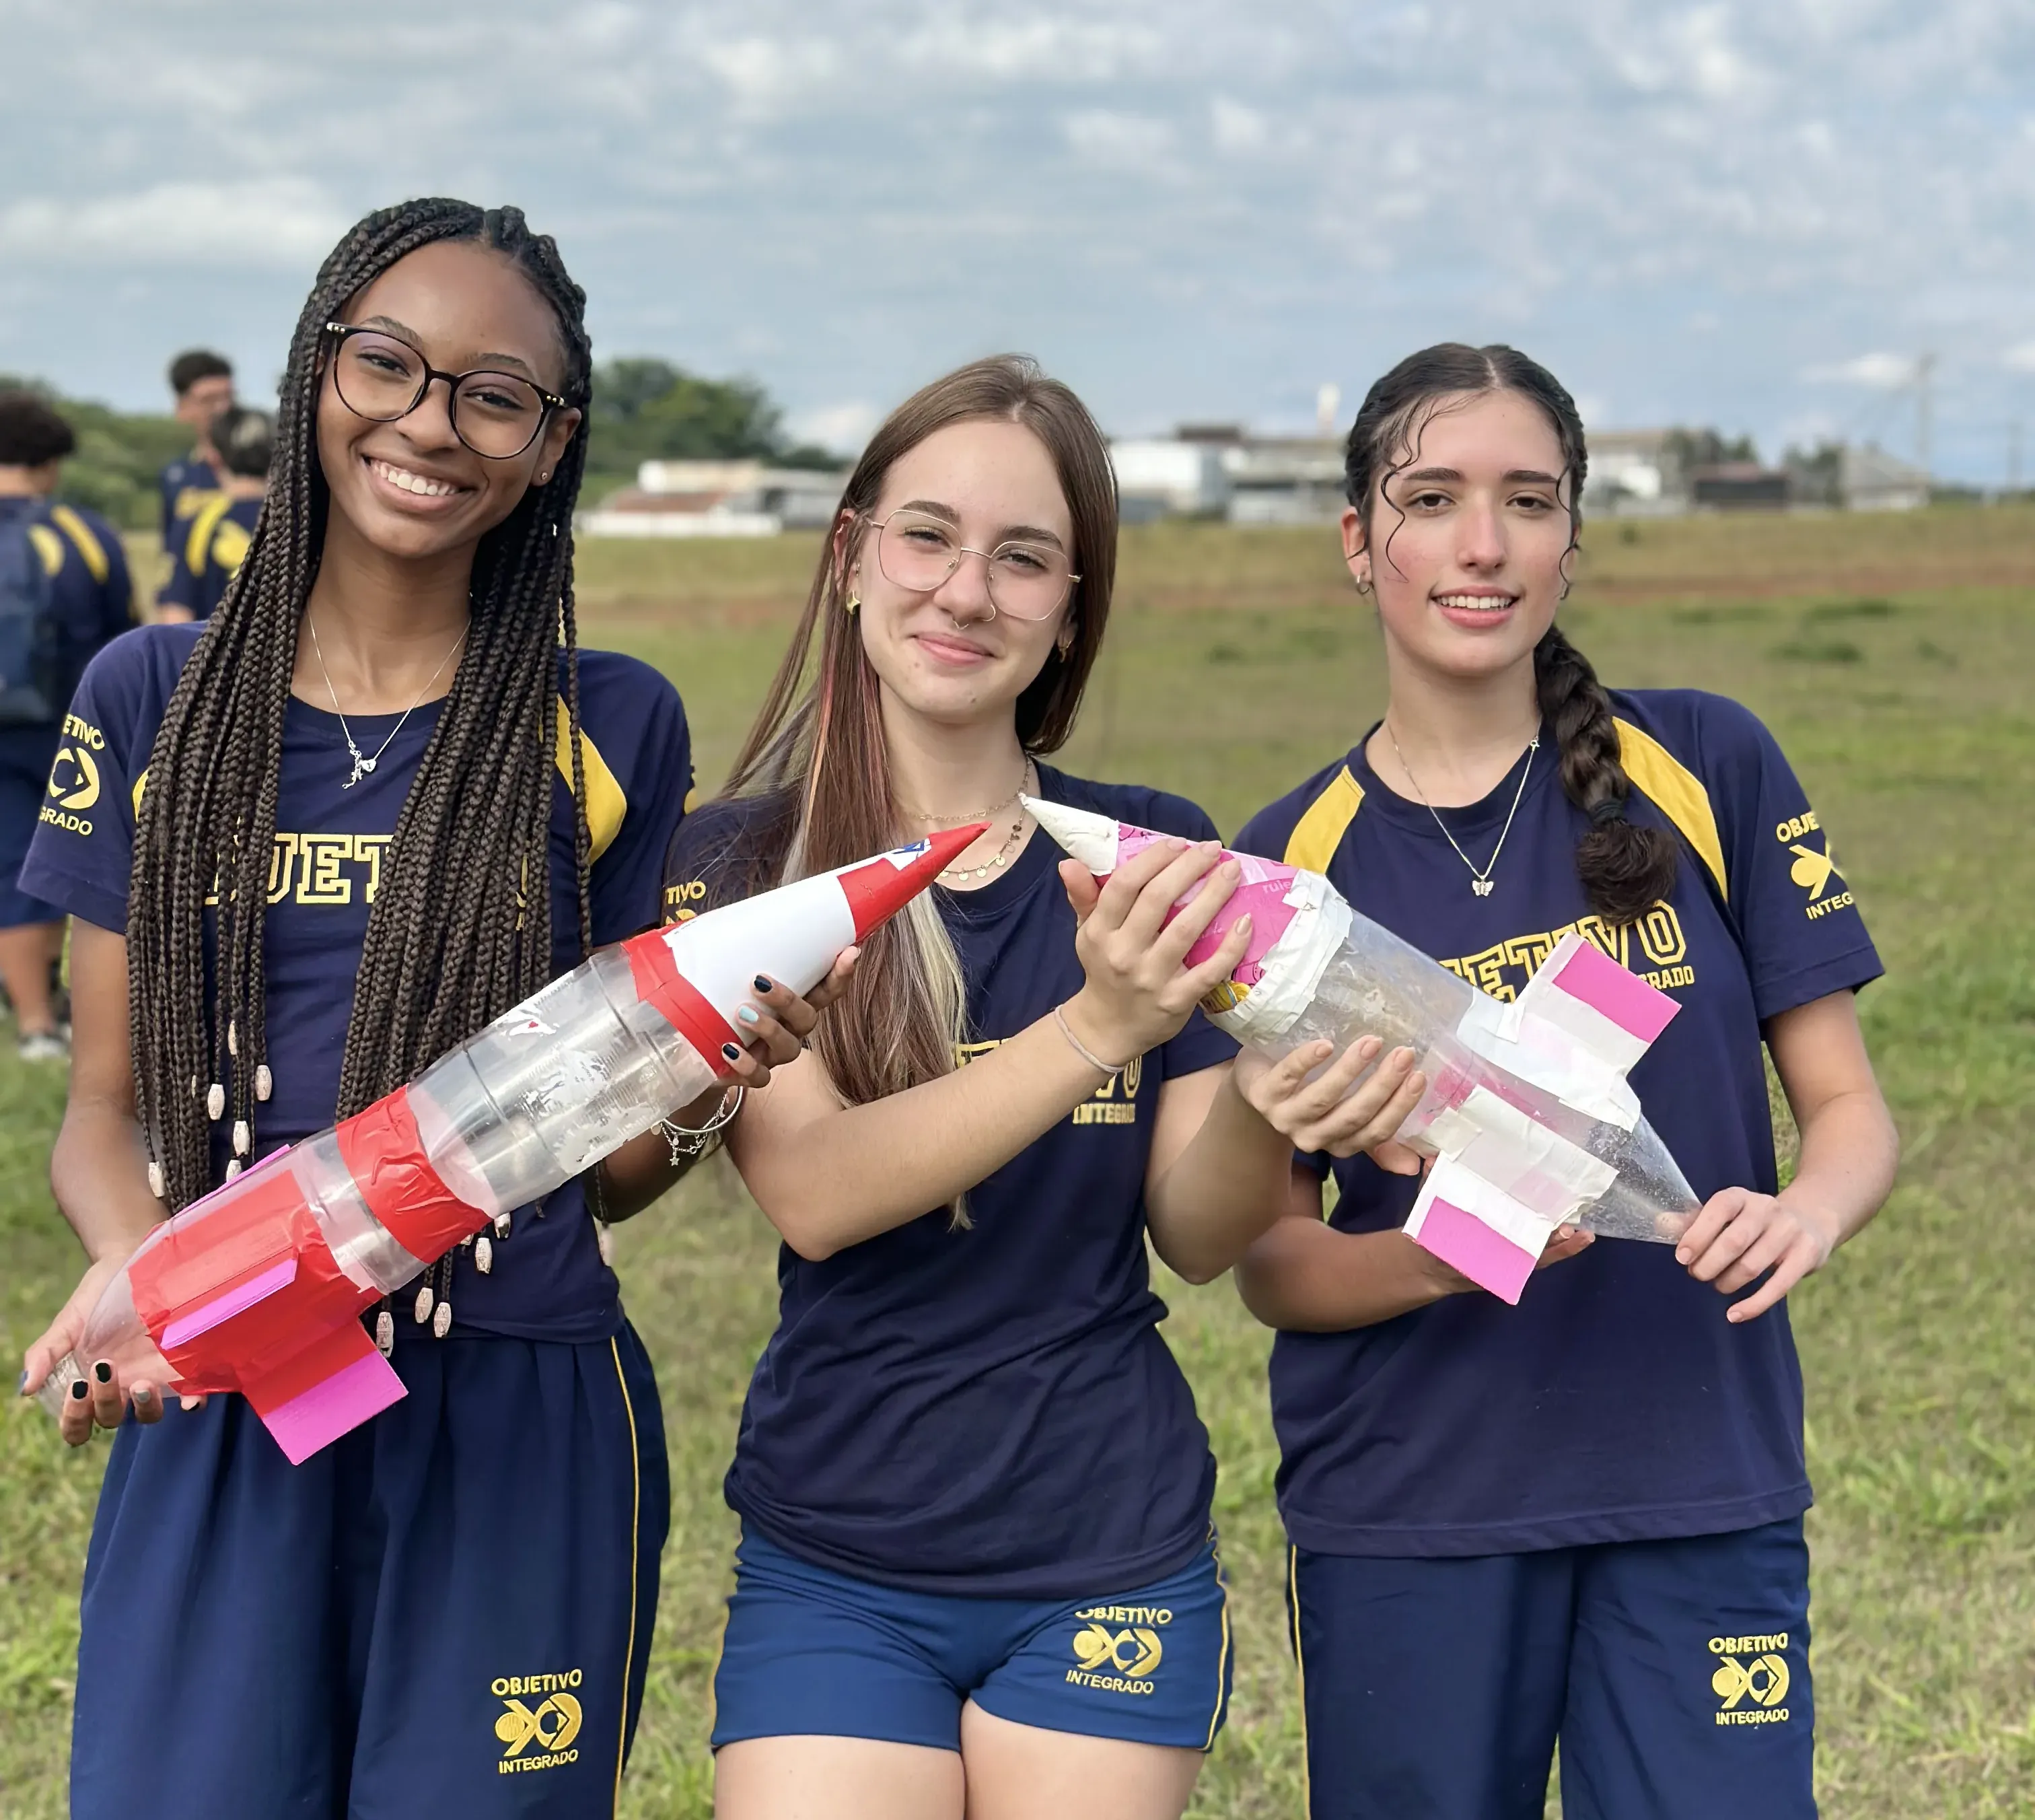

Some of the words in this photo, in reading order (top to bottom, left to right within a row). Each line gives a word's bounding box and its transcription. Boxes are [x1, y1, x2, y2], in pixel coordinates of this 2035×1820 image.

[1708, 1632, 1788, 1653] OBJETIVO
[491, 1669, 582, 1695] OBJETIVO
[1065, 1670, 1154, 1694] INTEGRADO
[1716, 1708, 1789, 1725] INTEGRADO
[499, 1749, 579, 1774] INTEGRADO
